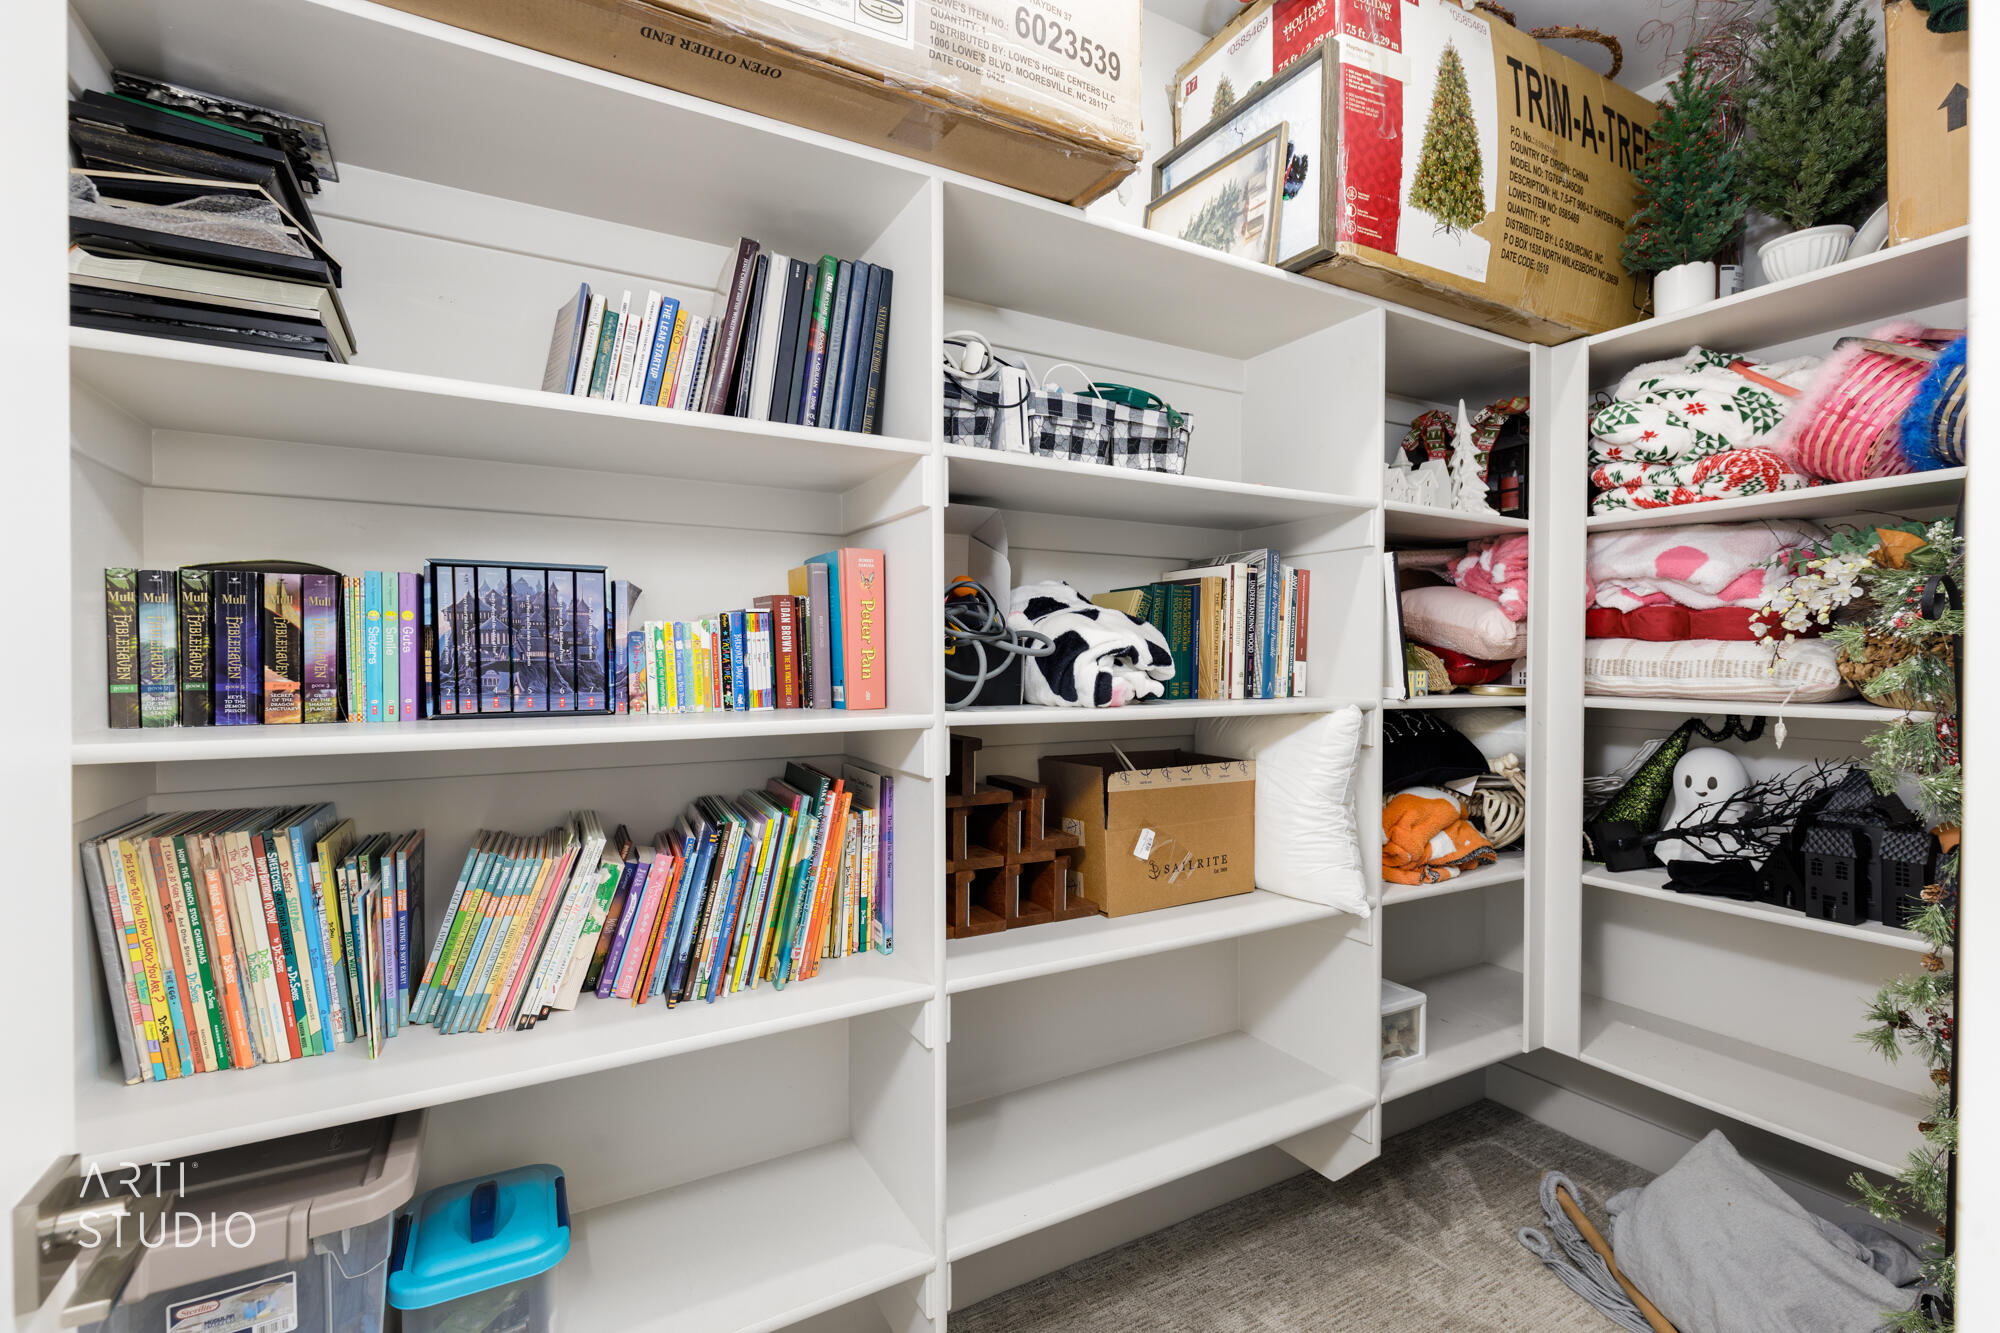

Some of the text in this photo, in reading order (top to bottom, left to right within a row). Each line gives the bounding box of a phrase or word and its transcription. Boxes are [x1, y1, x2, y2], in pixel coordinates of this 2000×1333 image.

[968, 7, 991, 23] ITEM
[1064, 11, 1072, 22] 37
[1283, 0, 1327, 35] HOLIDAY
[640, 26, 782, 79] OPEN OTHER END
[1015, 6, 1121, 82] 6023539
[929, 49, 954, 66] DATE
[930, 20, 1116, 104] DISTRIBUTED BY: LOWE'S HOME CENTERS LLC
[930, 35, 950, 50] 1000
[952, 42, 986, 63] LOWE'S
[1076, 91, 1087, 102] NC
[1088, 97, 1108, 111] 28117
[1510, 155, 1543, 178] MODEL NO:
[1511, 141, 1539, 160] COUNTRY
[1540, 154, 1549, 164] OF
[1550, 158, 1571, 175] ORIGIN:
[1572, 167, 1590, 183] CHINA
[1508, 186, 1580, 224] LOWE'S ITEM NO: 0585469
[1509, 171, 1550, 195] DESCRIPTION:
[1551, 190, 1559, 201] HL
[1594, 207, 1614, 225] HAYDEN
[1614, 216, 1625, 231] PINE
[1507, 202, 1551, 228] QUANTITY: 1PC
[1505, 217, 1544, 240] DISTRIBUTED
[1545, 232, 1554, 245] BY:
[1554, 237, 1558, 246] L
[1560, 239, 1564, 249] G
[1501, 248, 1549, 275] DATE CODE: 0518
[1503, 233, 1508, 242] P
[1509, 235, 1514, 246] O
[1515, 237, 1528, 251] BOX
[1530, 242, 1541, 256] 1535
[1542, 245, 1561, 264] NORTH
[1562, 255, 1598, 278] WILKESBORO
[1598, 270, 1605, 281] NC
[738, 271, 746, 291] CHRIST
[826, 275, 834, 292] ONE
[662, 304, 673, 320] THE
[822, 293, 832, 315] SKYLINE
[628, 324, 638, 344] START
[658, 321, 669, 342] LEAN
[673, 318, 685, 345] ZERO
[871, 304, 888, 374] SKYLINE HIGH SCHOOL
[623, 344, 634, 361] WITH
[816, 332, 826, 355] SCHOOL
[650, 341, 665, 379] STARTUP
[107, 591, 135, 602] Mull
[143, 592, 169, 603] Mull
[182, 591, 208, 602] Mull
[222, 594, 246, 604] Mull
[272, 595, 293, 604] Mull
[309, 596, 331, 606] Mull
[1248, 580, 1256, 632] UNDERSTANDING
[780, 607, 791, 624] DAN
[1271, 600, 1279, 633] Precision
[113, 615, 131, 680] FABLEHAVEN
[146, 616, 167, 680] FABLEHAVEN
[186, 615, 206, 679] FABLEHAVEN
[226, 617, 243, 679] FABLEHAVEN
[274, 617, 289, 678] FABLEHAVEN
[312, 618, 328, 679] FABLEHAVEN
[368, 626, 380, 665] Sisters
[385, 626, 398, 656] Smile
[402, 626, 414, 653] Guts
[734, 633, 743, 664] BARNYARD
[781, 624, 792, 653] BROWN
[861, 598, 876, 681] Peter Pan
[1269, 633, 1278, 658] Possible
[722, 638, 732, 683] PAJAMA TIME!
[446, 688, 451, 696] 2
[466, 687, 471, 696] 3
[527, 686, 533, 694] 5
[560, 686, 565, 694] 6
[820, 781, 828, 802] MAKE
[1164, 854, 1228, 874] SAILRITE
[256, 857, 273, 901] HAPPY BIRTHDAY
[128, 870, 144, 917] Ever You
[267, 852, 293, 957] SNEETCHES OTHER STORIES
[177, 848, 207, 965] HOW THE GRINCH STOLE CHRISTMAS
[214, 914, 227, 937] WHO!
[604, 917, 618, 935] Wish
[184, 945, 192, 965] Stories
[400, 943, 406, 951] IS
[223, 963, 235, 985] Seuss
[260, 958, 273, 979] Seuss
[273, 955, 286, 974] Seuss
[348, 956, 358, 979] WHEELS
[164, 971, 176, 1000] THE EGG
[188, 983, 202, 1005] Seuss
[289, 982, 300, 1001] Seuss
[304, 979, 312, 1002] RANDOM
[159, 1025, 170, 1043] Seuss
